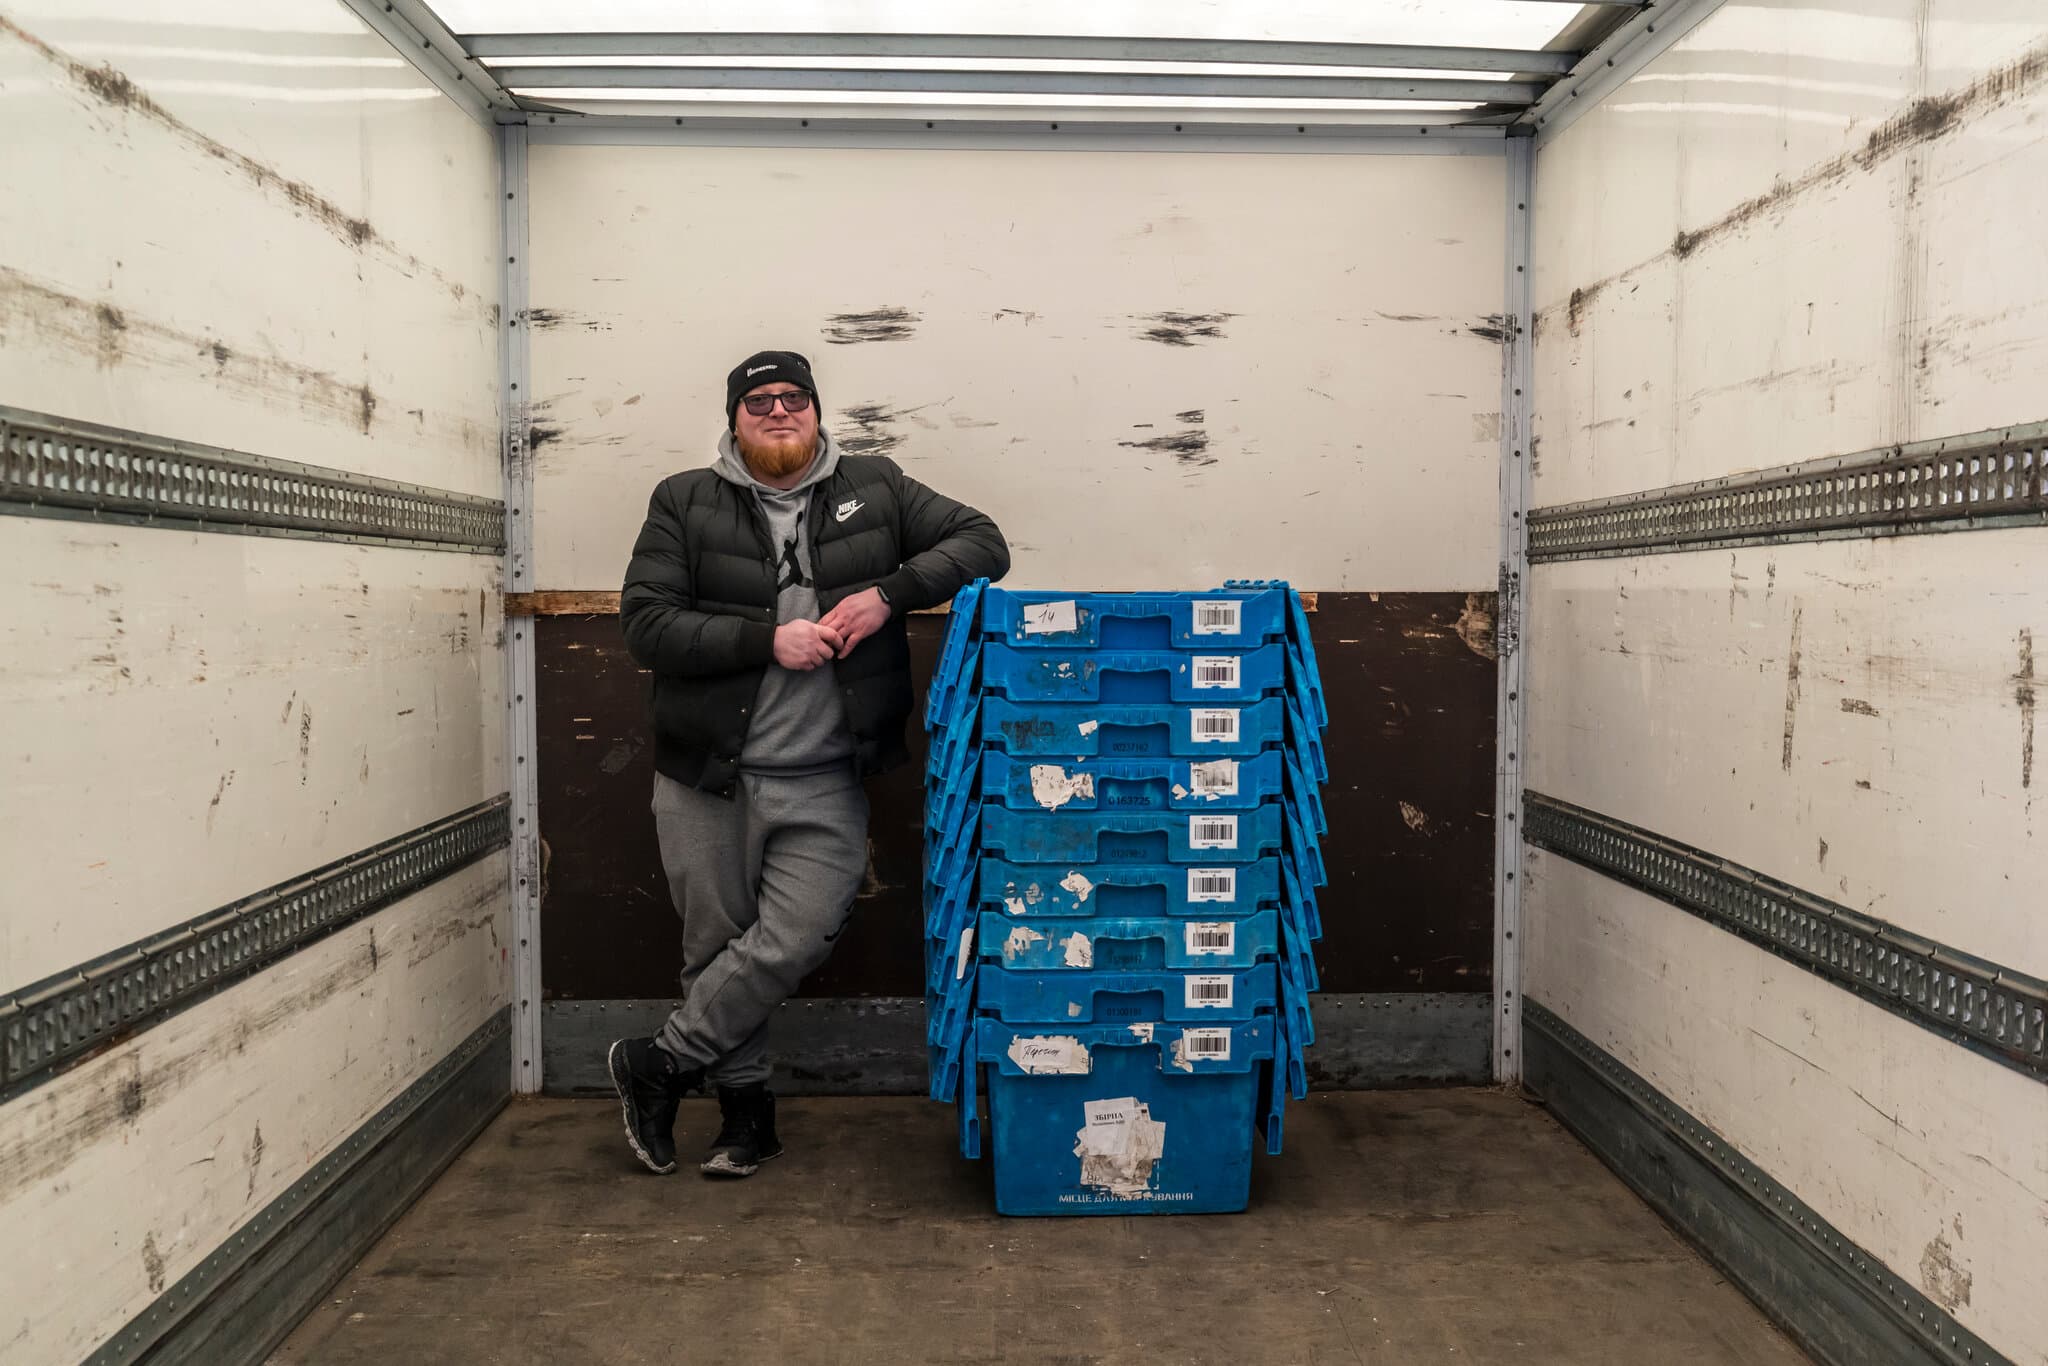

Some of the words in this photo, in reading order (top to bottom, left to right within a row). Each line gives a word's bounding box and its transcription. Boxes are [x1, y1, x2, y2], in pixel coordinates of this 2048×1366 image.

[838, 499, 857, 515] NIKE
[1038, 609, 1055, 624] 14
[1058, 1193, 1092, 1204] МІСЦЕ
